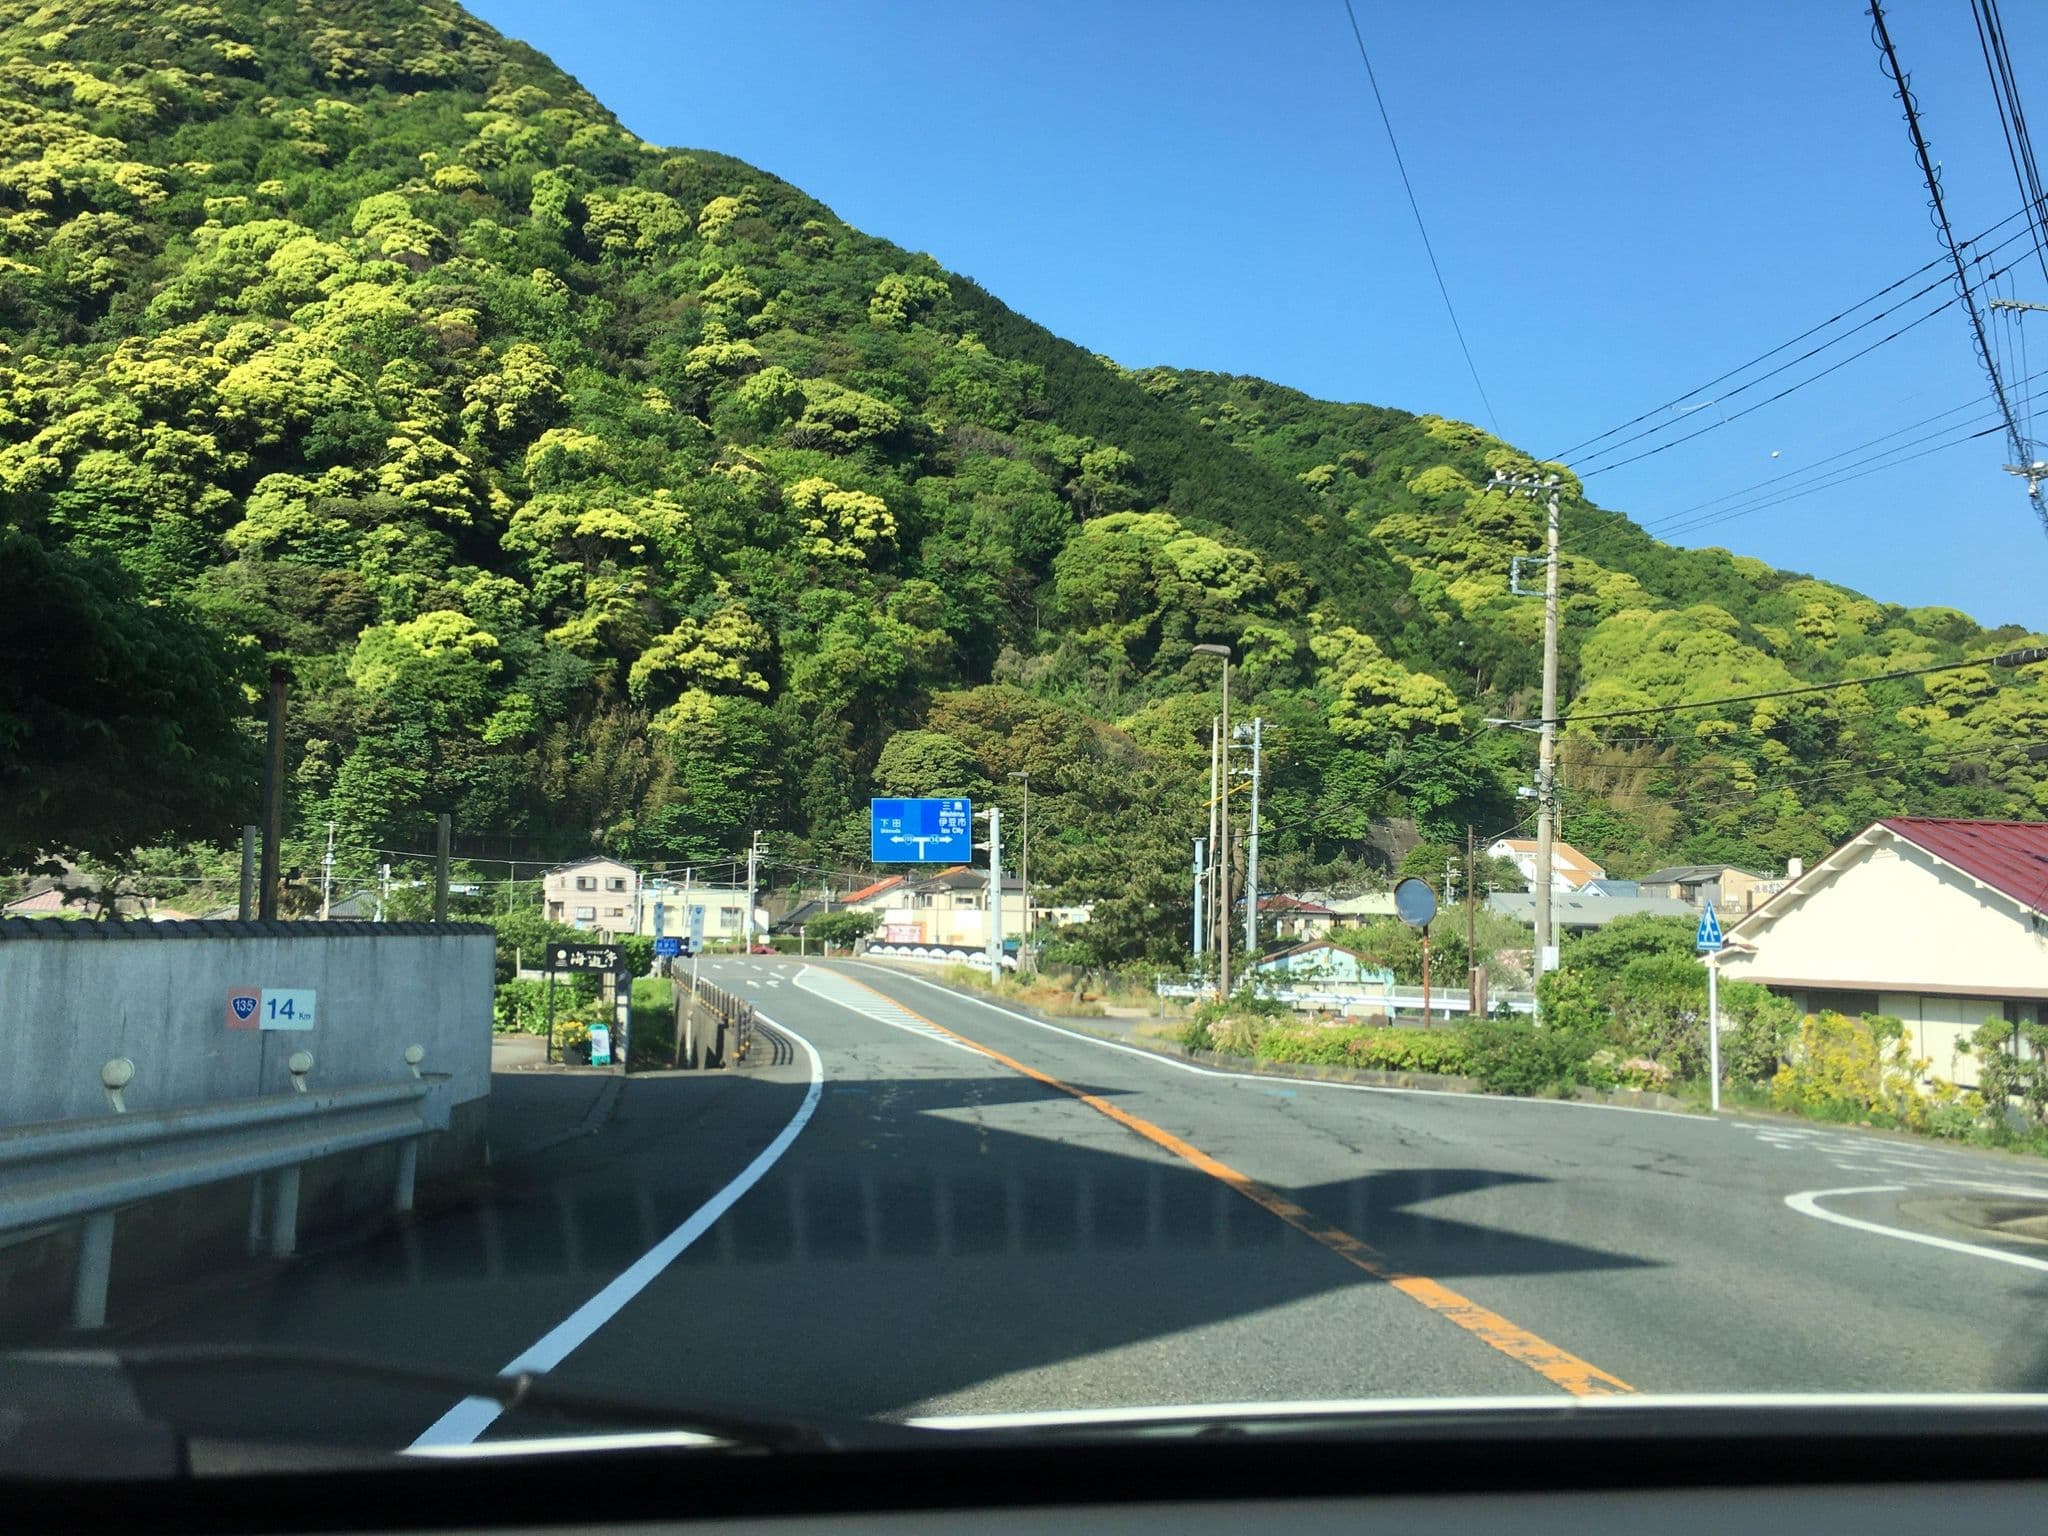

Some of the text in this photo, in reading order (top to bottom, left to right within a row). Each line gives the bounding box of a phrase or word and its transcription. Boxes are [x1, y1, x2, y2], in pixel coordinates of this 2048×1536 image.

[880, 819, 901, 828] 下田
[939, 817, 966, 827] 伊豆市
[952, 827, 963, 835] City
[235, 1000, 253, 1012] 135
[267, 998, 295, 1020] 14
